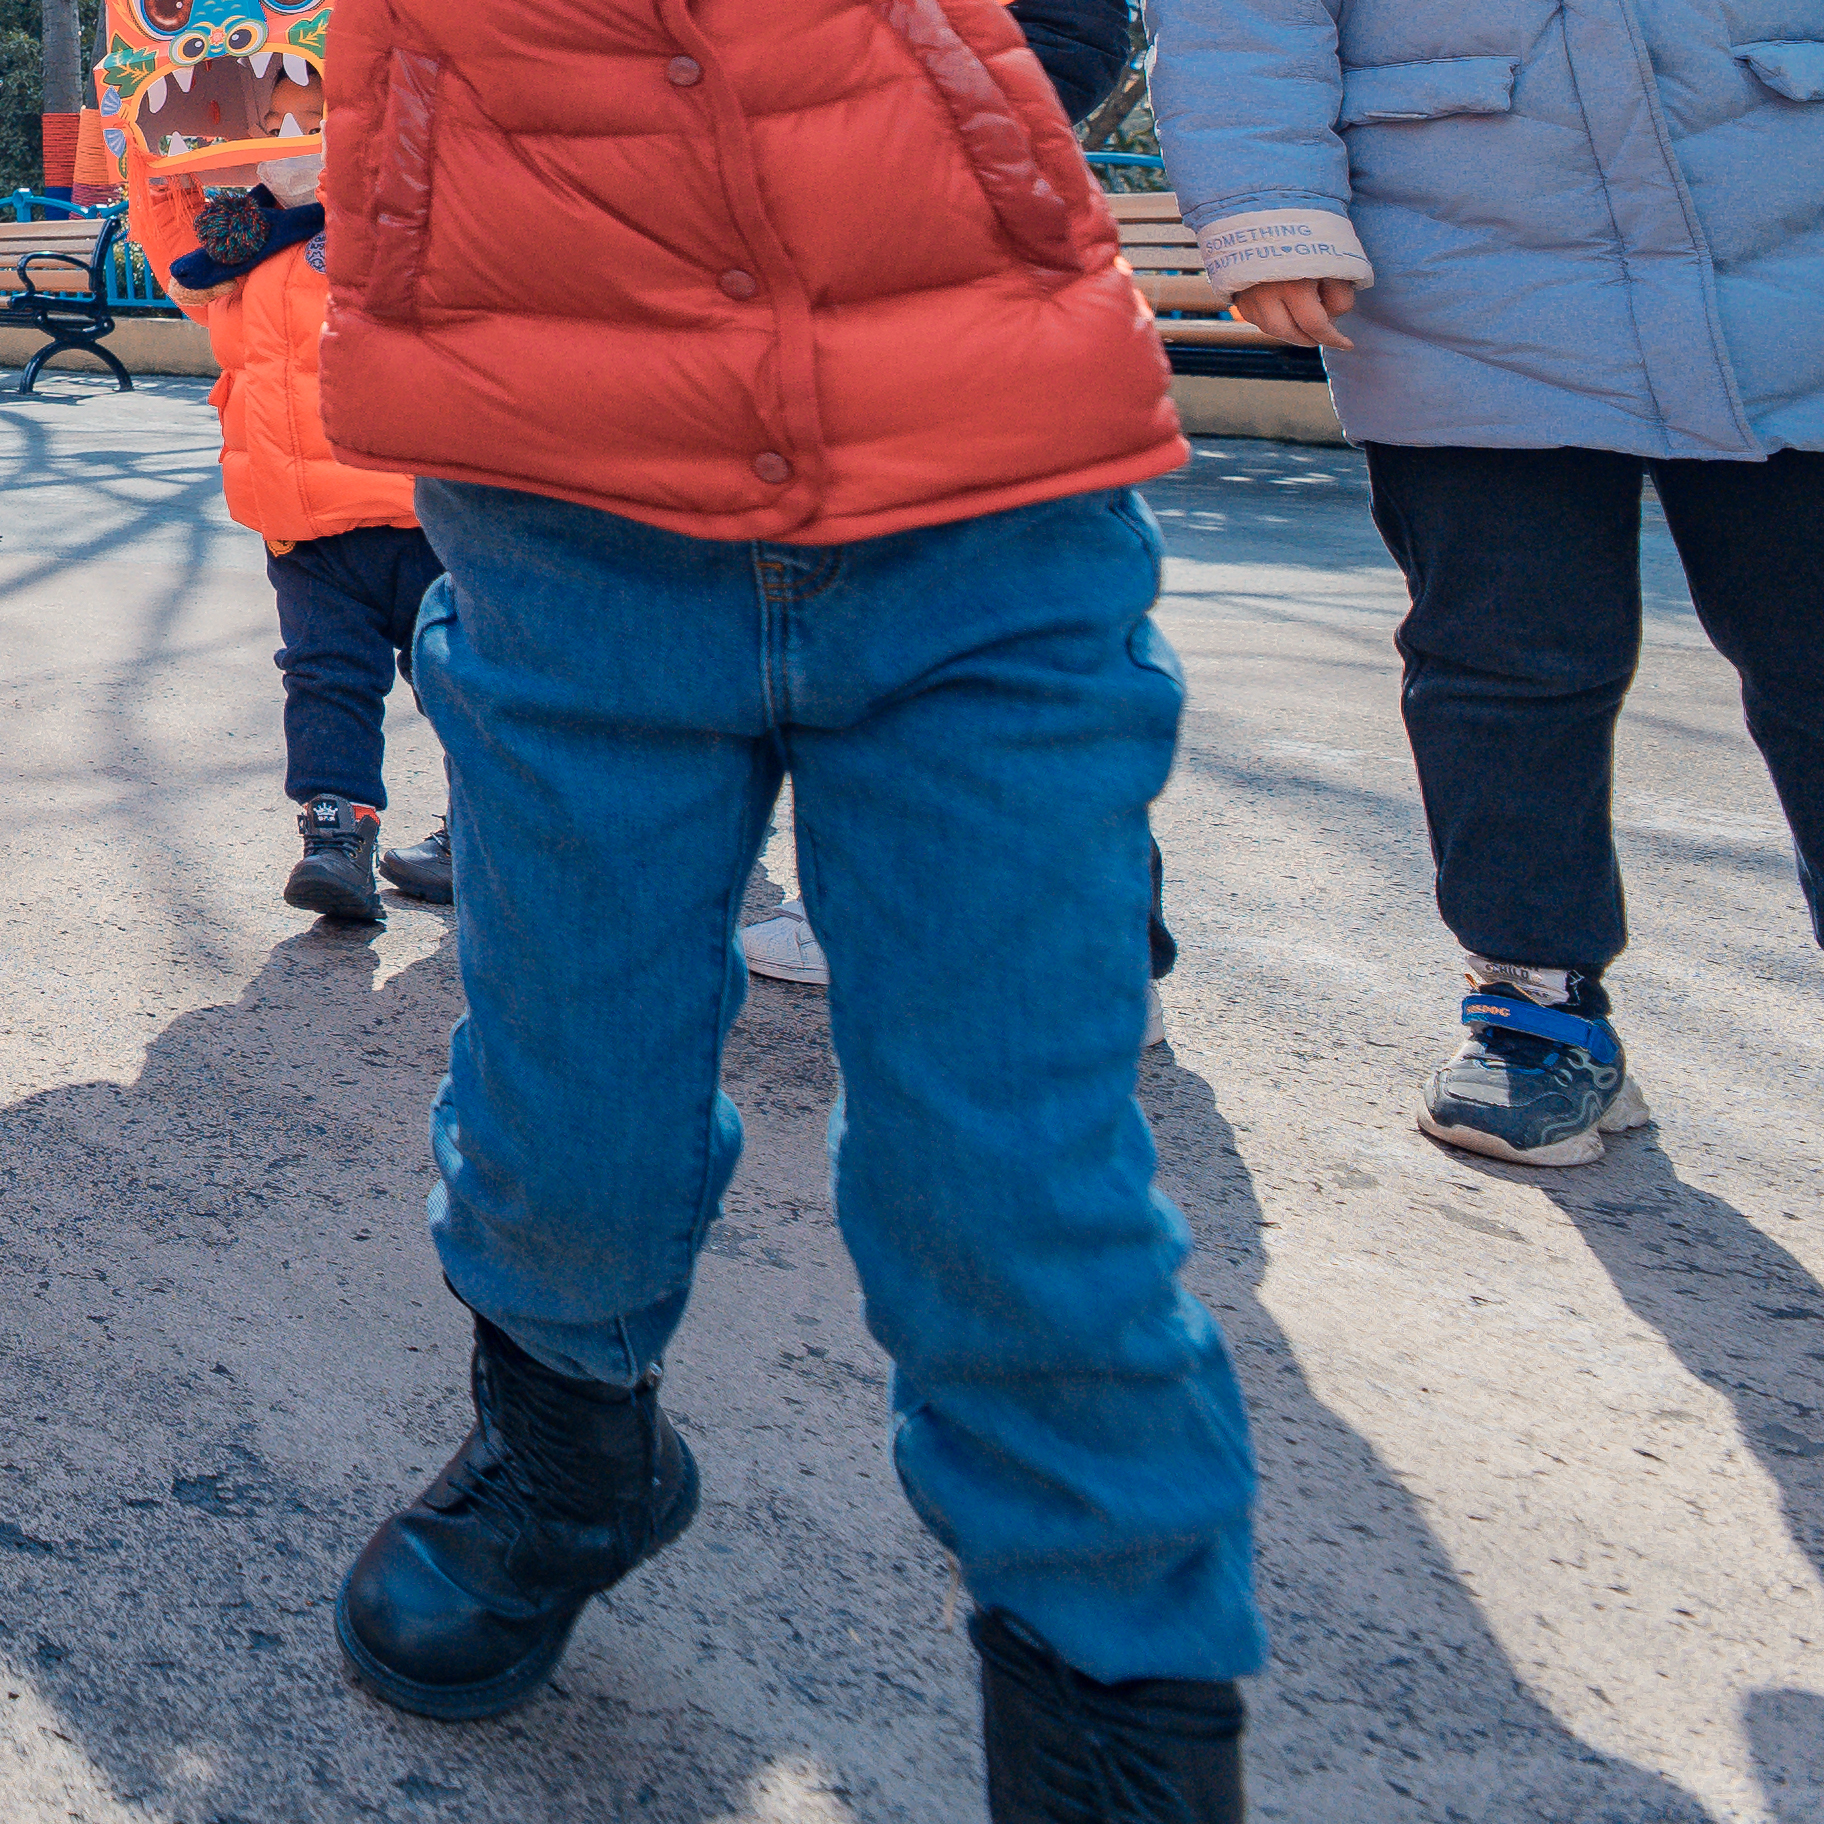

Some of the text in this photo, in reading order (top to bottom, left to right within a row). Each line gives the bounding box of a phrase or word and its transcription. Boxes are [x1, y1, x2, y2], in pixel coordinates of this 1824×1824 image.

[1206, 224, 1313, 254] SOMETHING
[1207, 242, 1343, 275] EAUTIFUL GIRL
